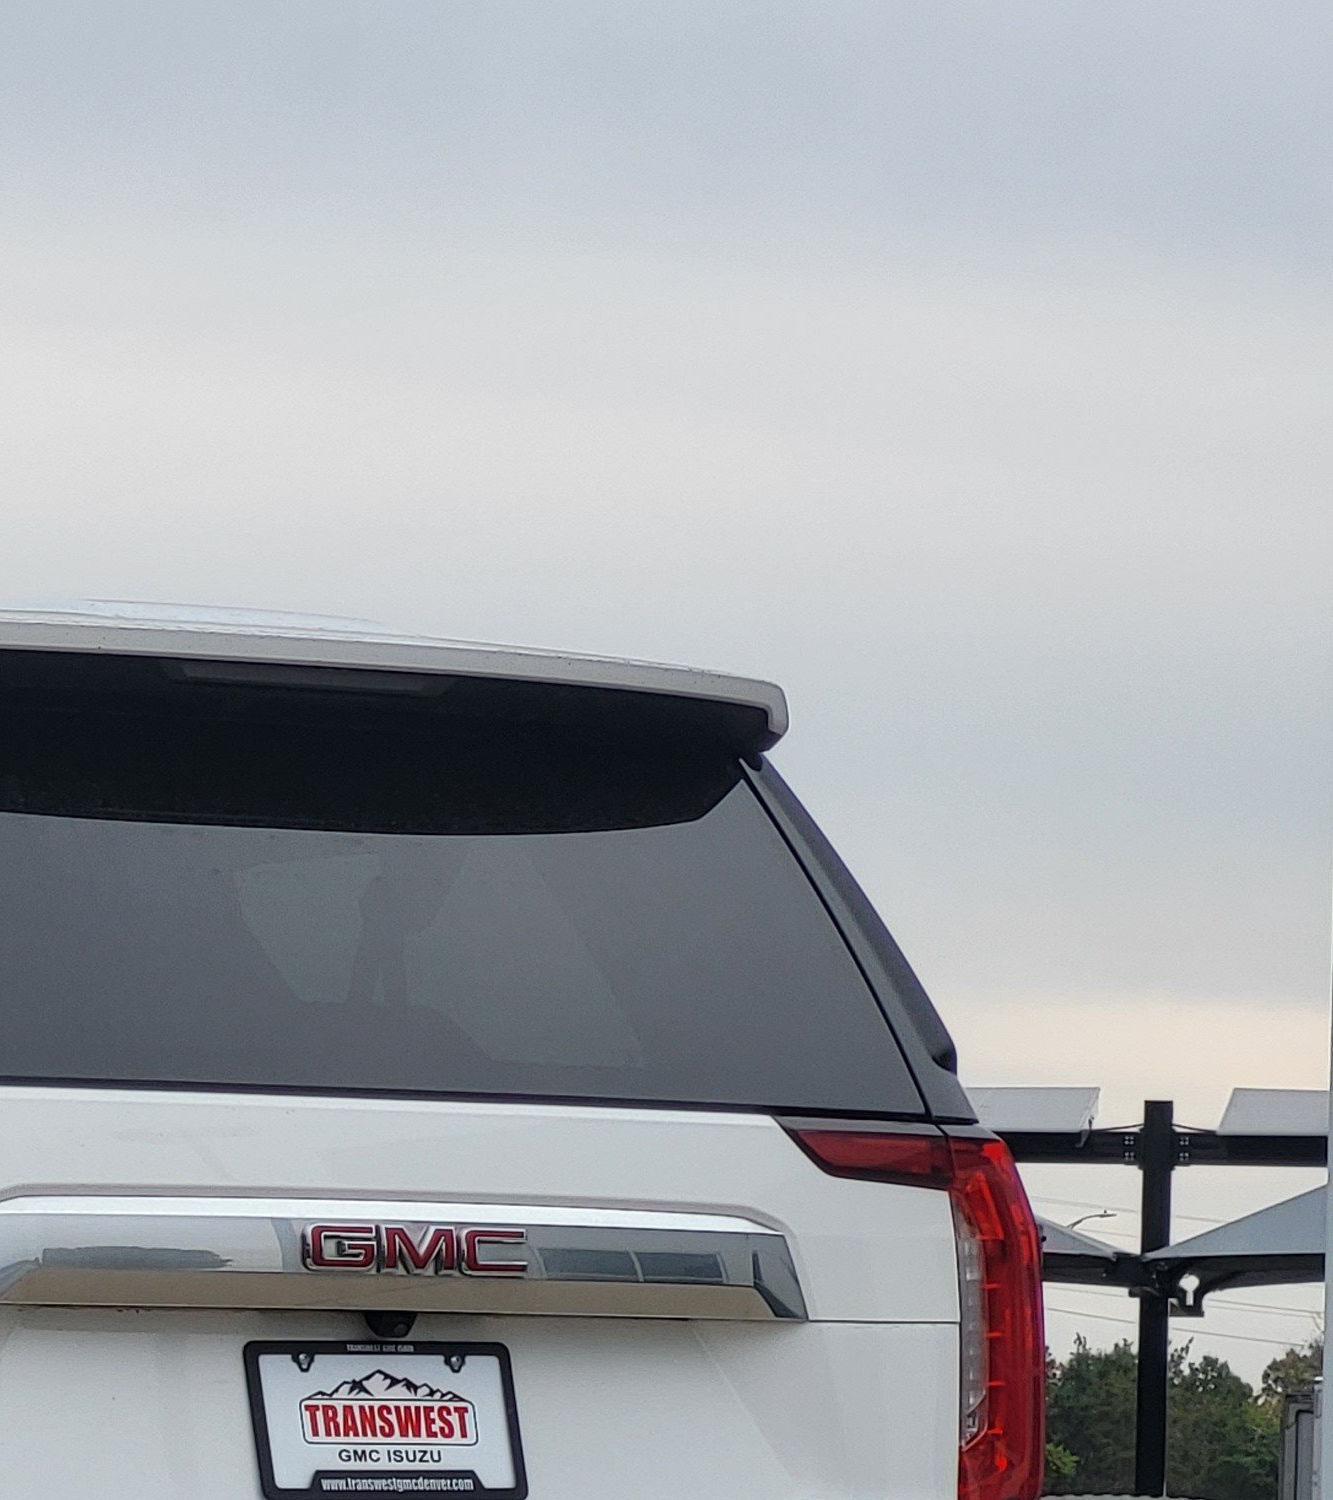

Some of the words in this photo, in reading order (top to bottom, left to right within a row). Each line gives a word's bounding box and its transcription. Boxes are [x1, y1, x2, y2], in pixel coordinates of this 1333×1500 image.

[302, 1222, 529, 1278] GMC
[304, 1404, 469, 1439] TRANSWEST
[338, 1449, 381, 1463] GMC
[387, 1449, 442, 1463] ISUZU
[321, 1477, 474, 1493] www.transwestgmcdenver.com
